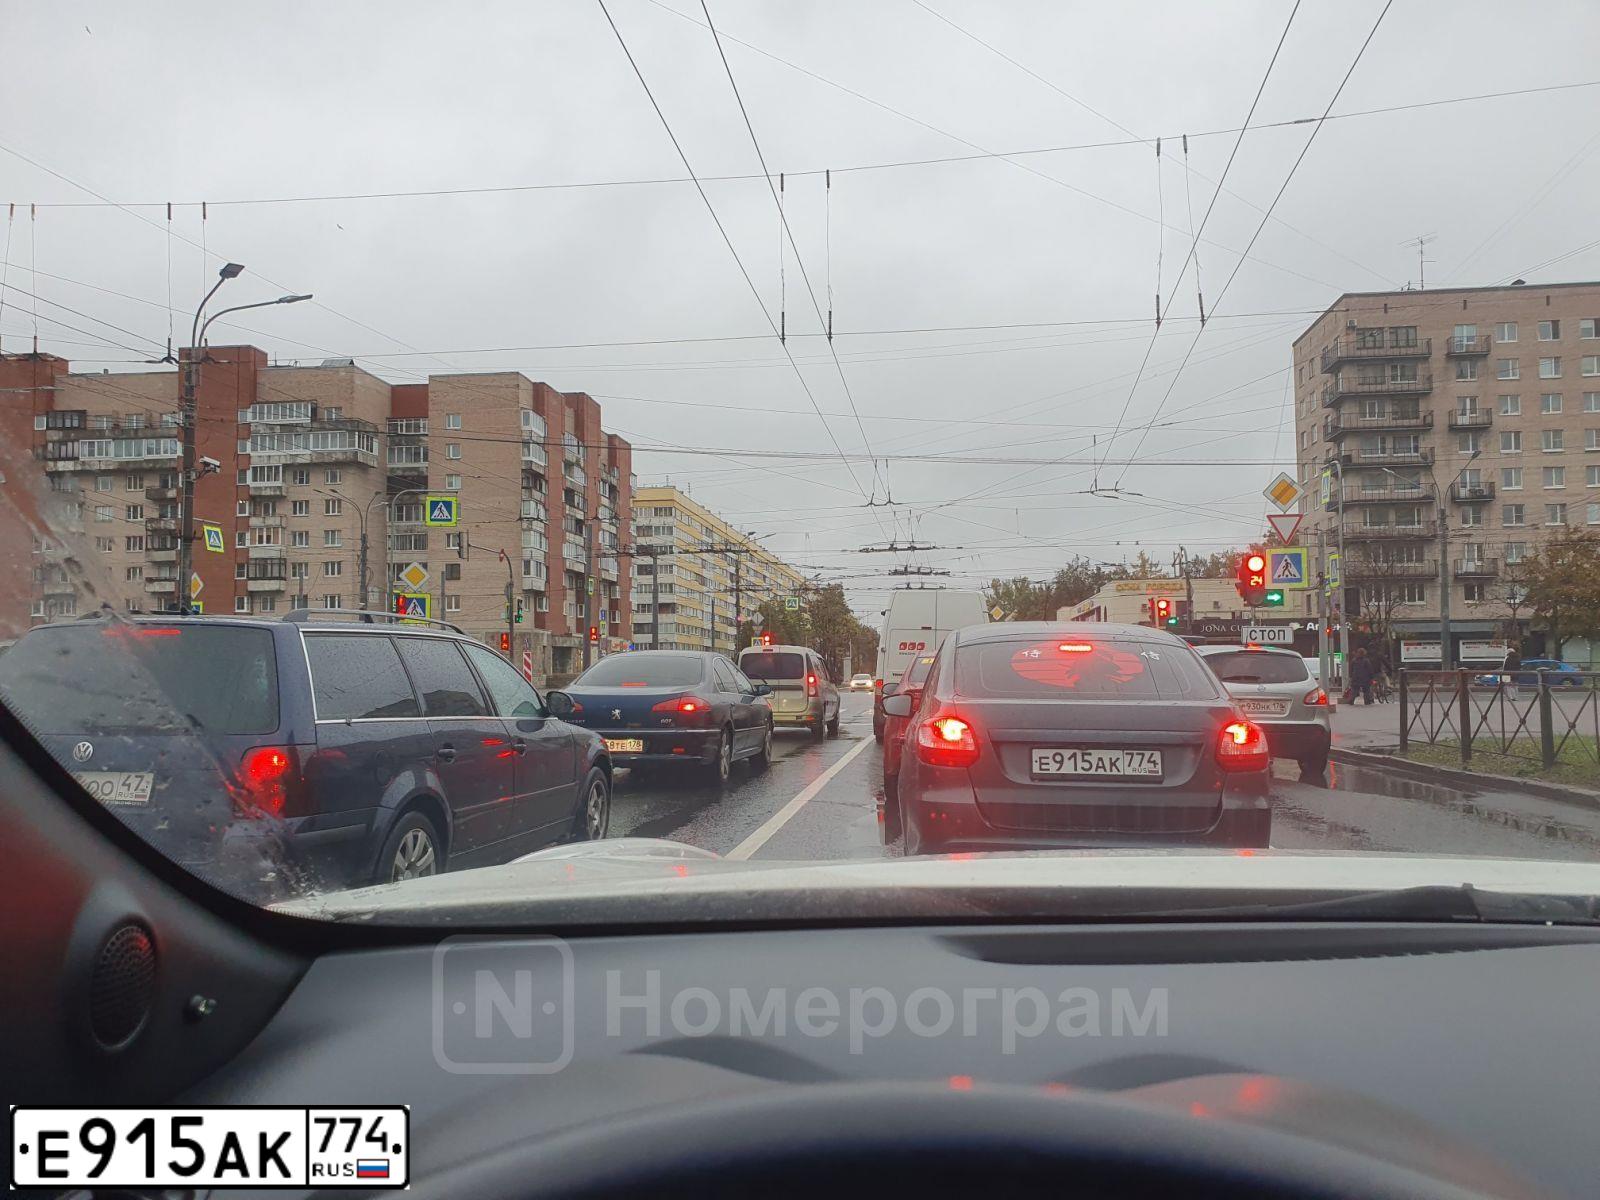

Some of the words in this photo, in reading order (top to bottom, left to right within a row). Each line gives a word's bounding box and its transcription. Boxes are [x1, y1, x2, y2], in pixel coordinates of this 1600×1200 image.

[1250, 576, 1263, 586] 24
[1200, 624, 1227, 633] JONA
[1249, 629, 1286, 641] СТОП
[1038, 751, 1121, 773] Е915АК
[1125, 752, 1159, 768] 774
[121, 775, 145, 792] 47
[117, 791, 135, 799] RUS
